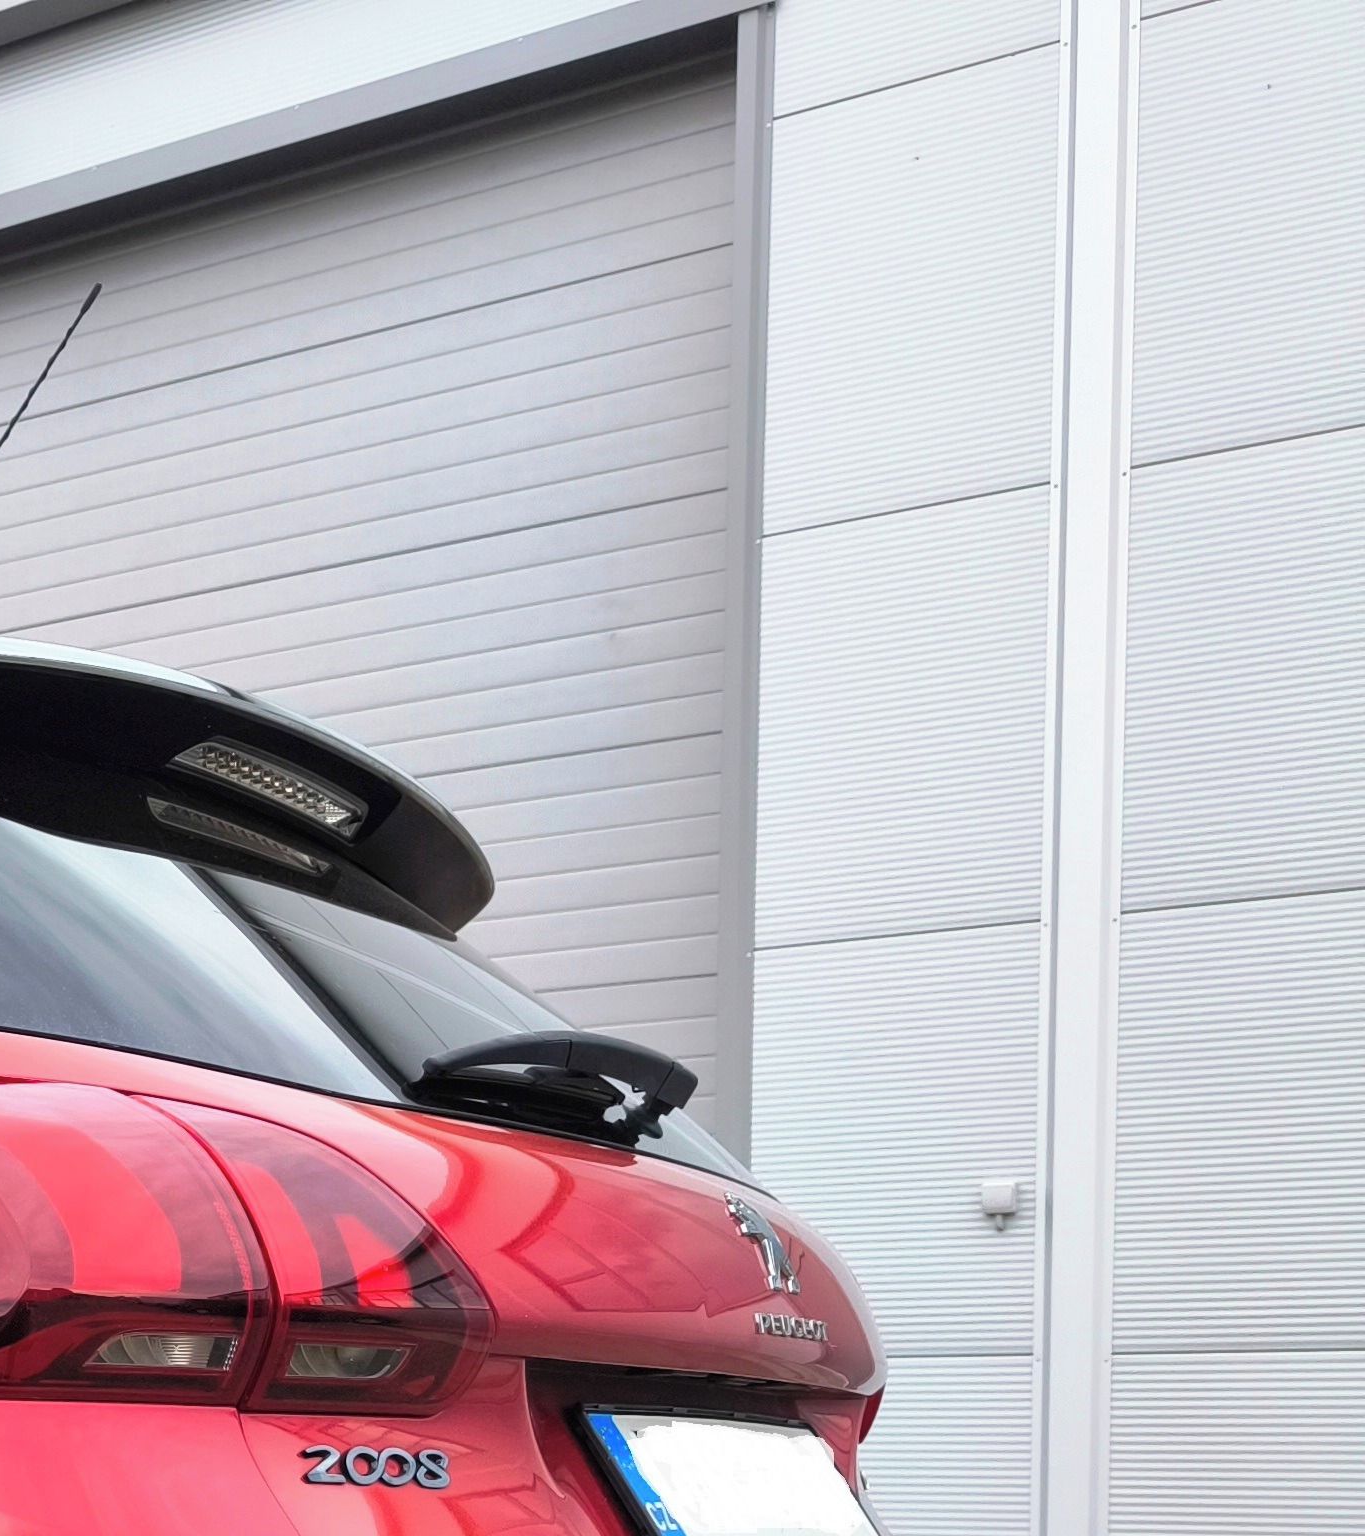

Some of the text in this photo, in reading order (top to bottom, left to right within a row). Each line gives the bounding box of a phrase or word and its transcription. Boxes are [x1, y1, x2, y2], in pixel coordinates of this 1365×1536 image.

[753, 1312, 829, 1342] PEUGEOT
[302, 1444, 451, 1489] 2008
[644, 1501, 679, 1531] CZ
